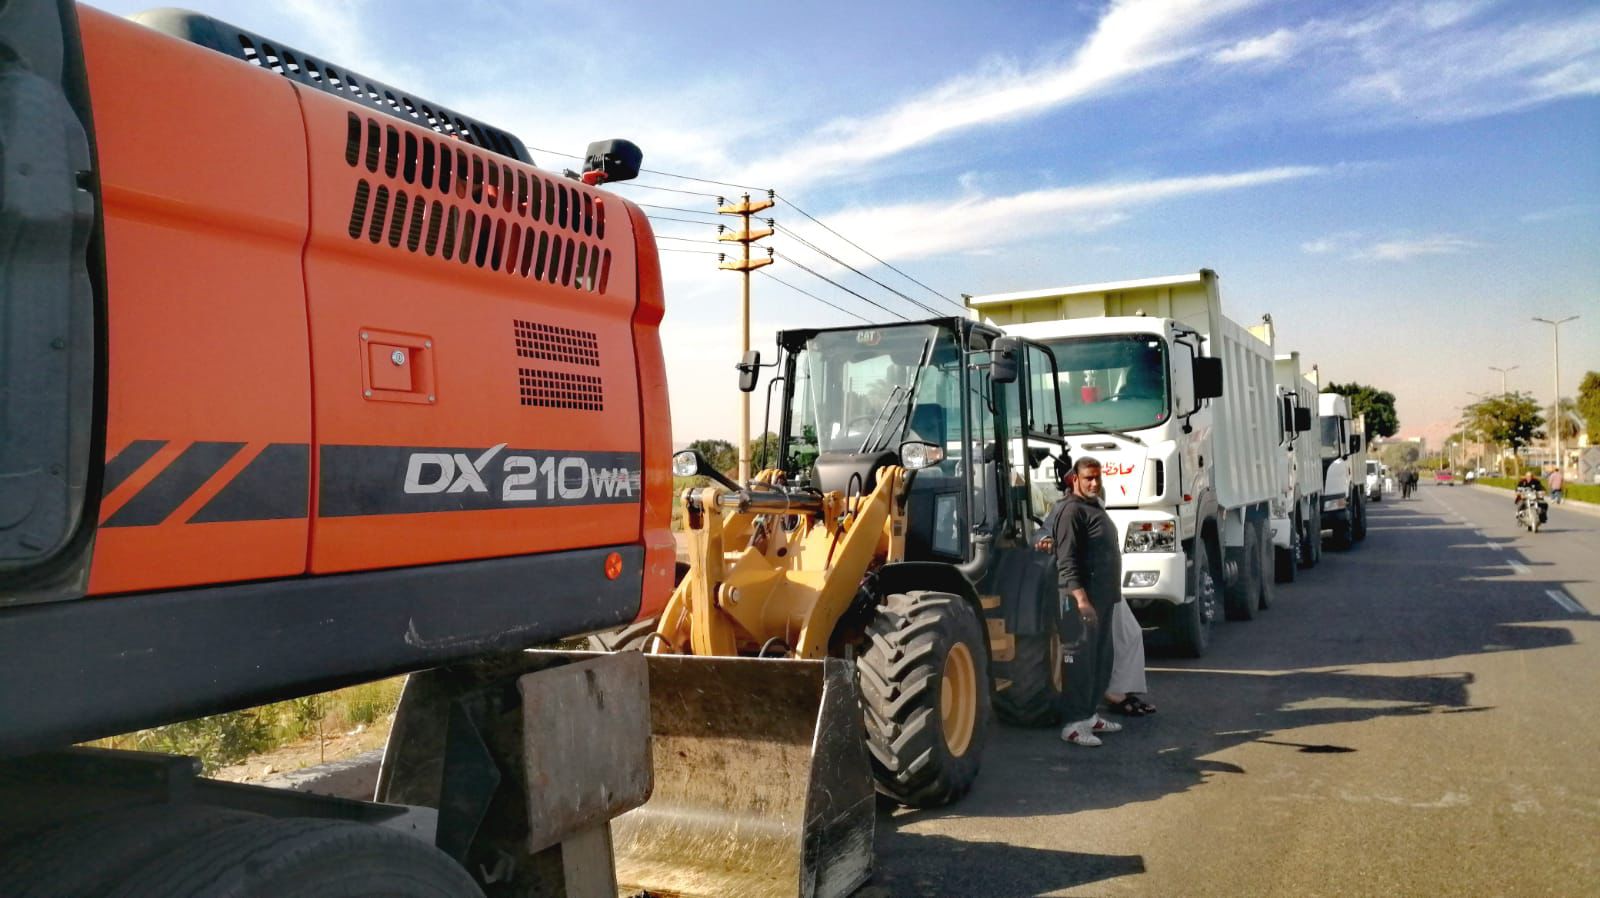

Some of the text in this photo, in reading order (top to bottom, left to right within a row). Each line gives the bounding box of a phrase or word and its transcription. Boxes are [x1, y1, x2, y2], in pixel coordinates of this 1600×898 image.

[857, 330, 876, 342] CAT
[403, 442, 634, 501] DX 210WA
